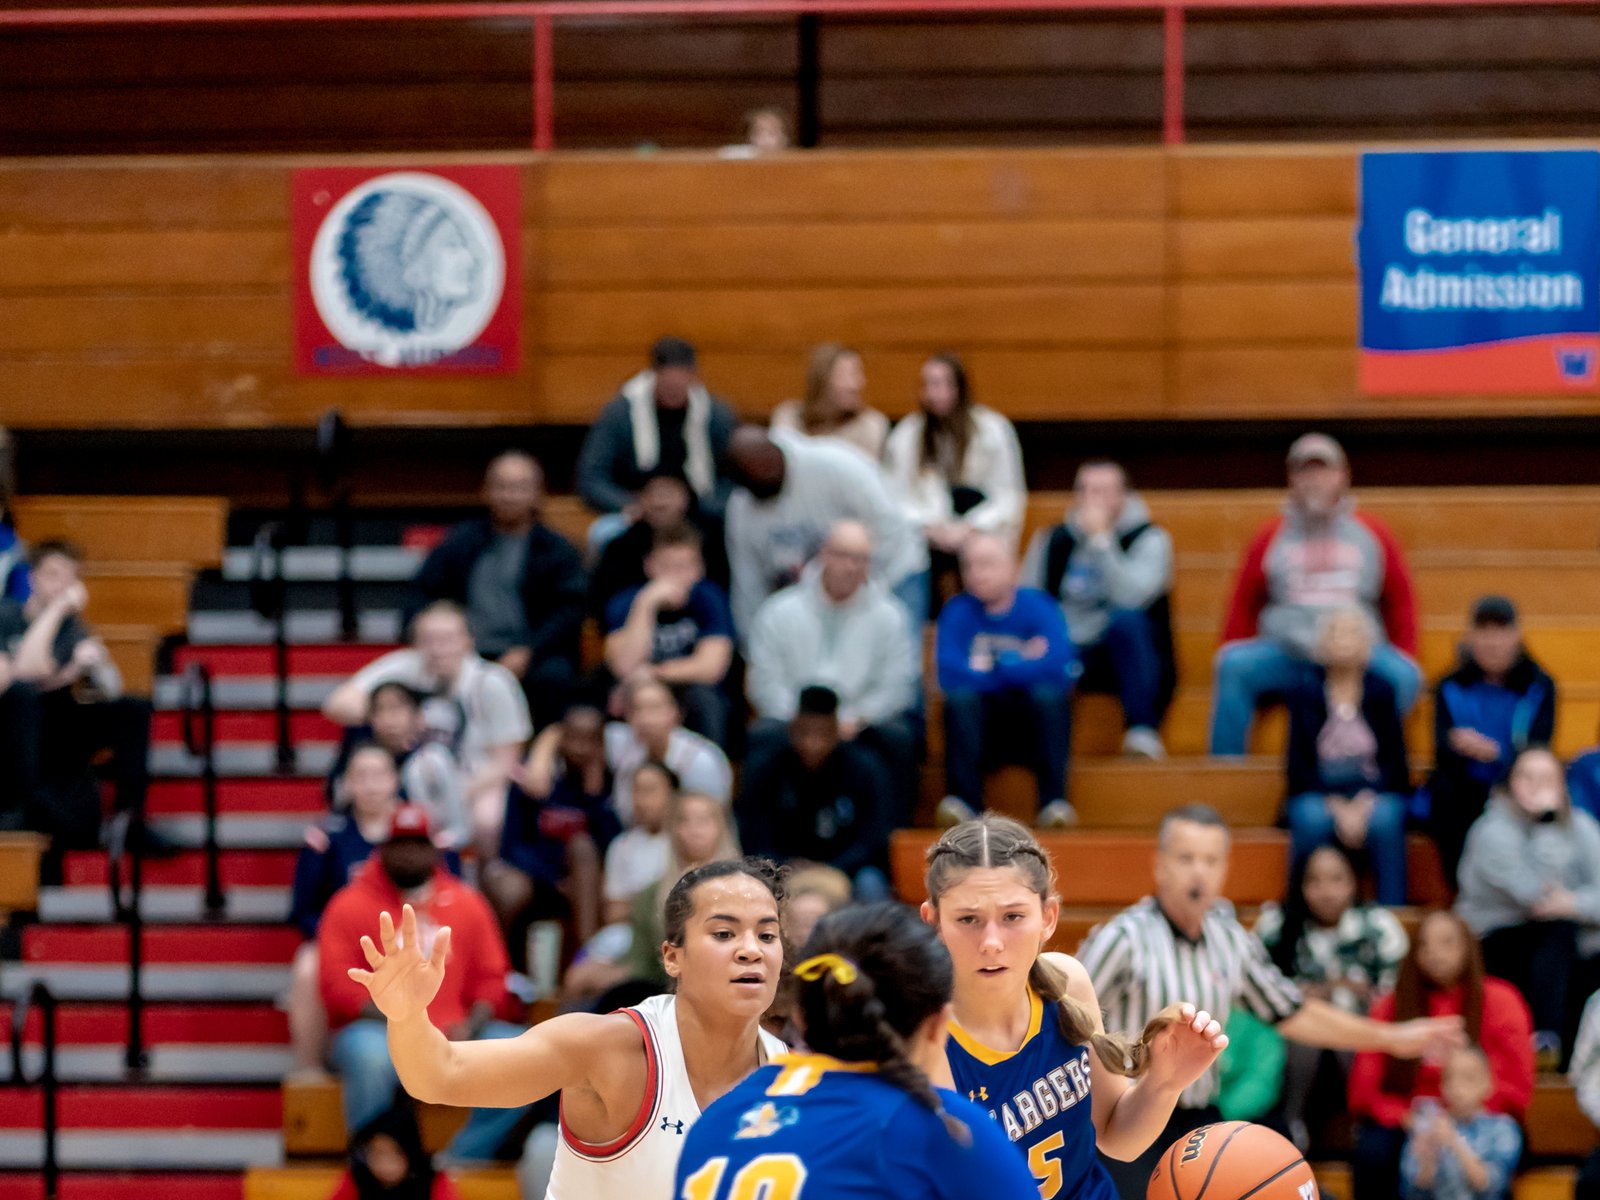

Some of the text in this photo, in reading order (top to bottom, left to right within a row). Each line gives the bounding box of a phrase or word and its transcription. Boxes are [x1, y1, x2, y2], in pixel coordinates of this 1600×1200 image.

[1404, 208, 1560, 255] General
[1381, 266, 1584, 311] Admission
[988, 1050, 1092, 1142] ARGERS
[1028, 1129, 1065, 1200] 5
